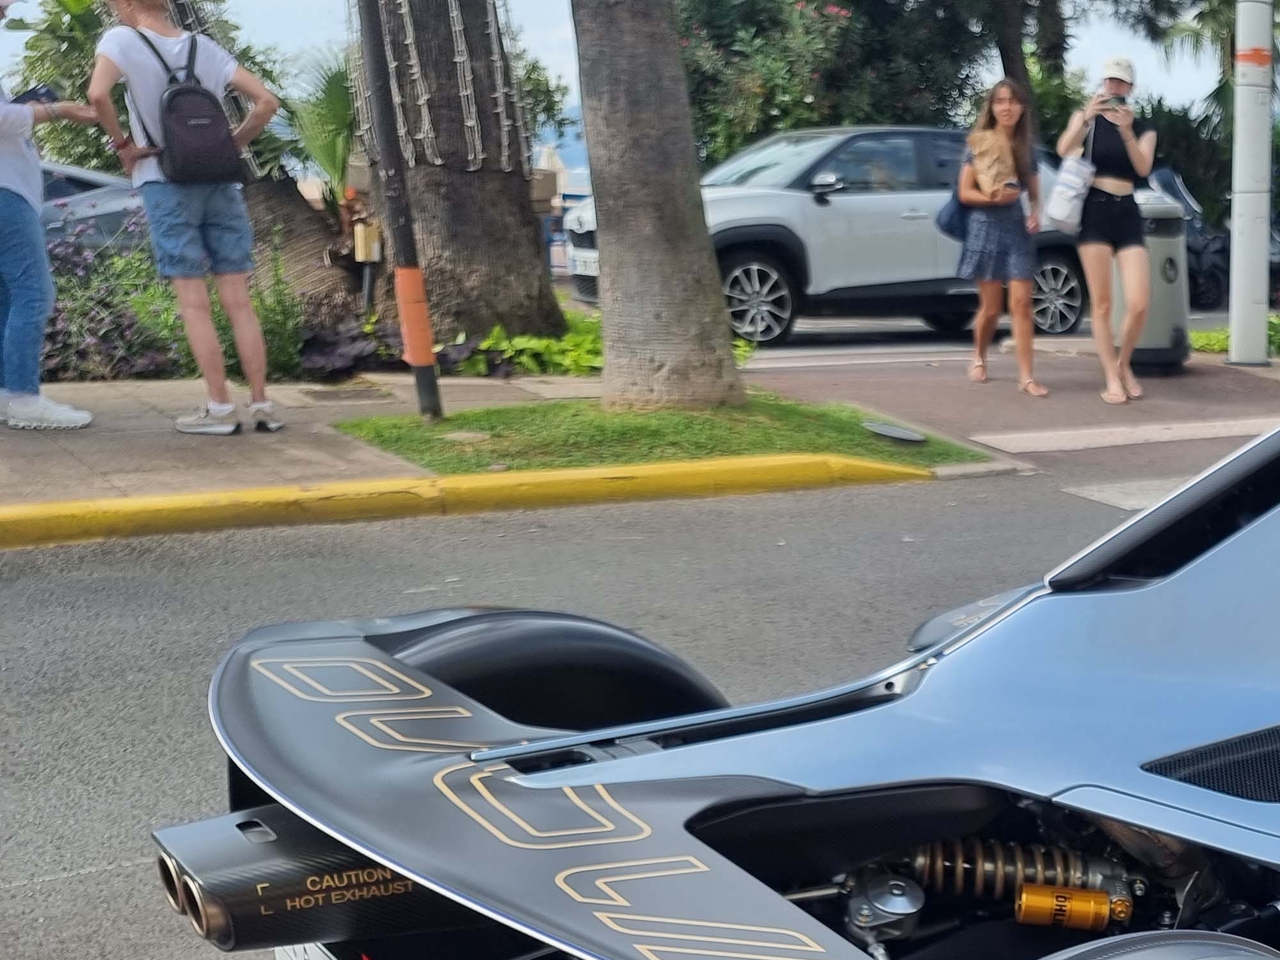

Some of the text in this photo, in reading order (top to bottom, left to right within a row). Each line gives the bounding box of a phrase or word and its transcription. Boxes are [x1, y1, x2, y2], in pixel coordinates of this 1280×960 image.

[306, 868, 392, 892] CAUTION
[286, 880, 415, 911] HOT EXHAUST
